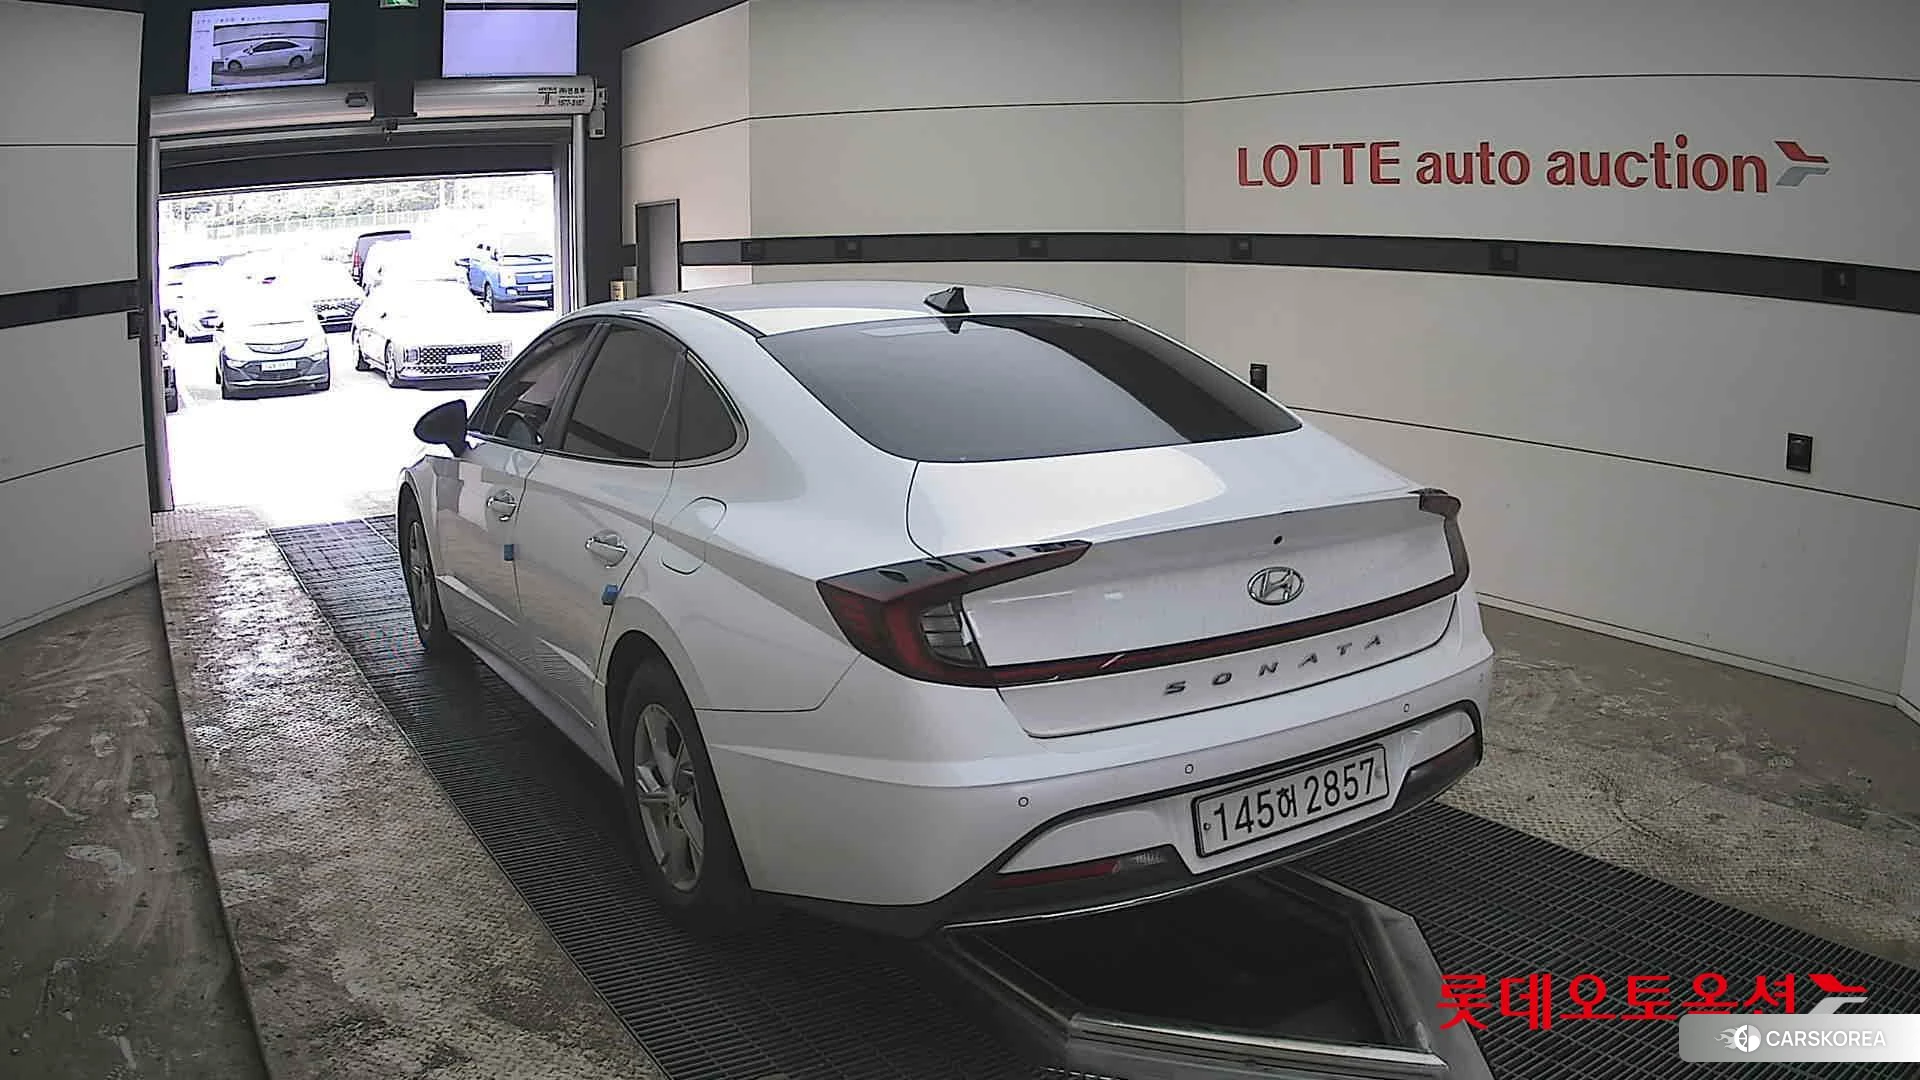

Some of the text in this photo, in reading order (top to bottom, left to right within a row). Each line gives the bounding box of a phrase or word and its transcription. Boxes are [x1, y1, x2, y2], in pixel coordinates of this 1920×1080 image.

[1237, 133, 1769, 194] LOTTE auto auction
[1163, 635, 1382, 696] SONATA
[1213, 757, 1375, 841] 145허 2857
